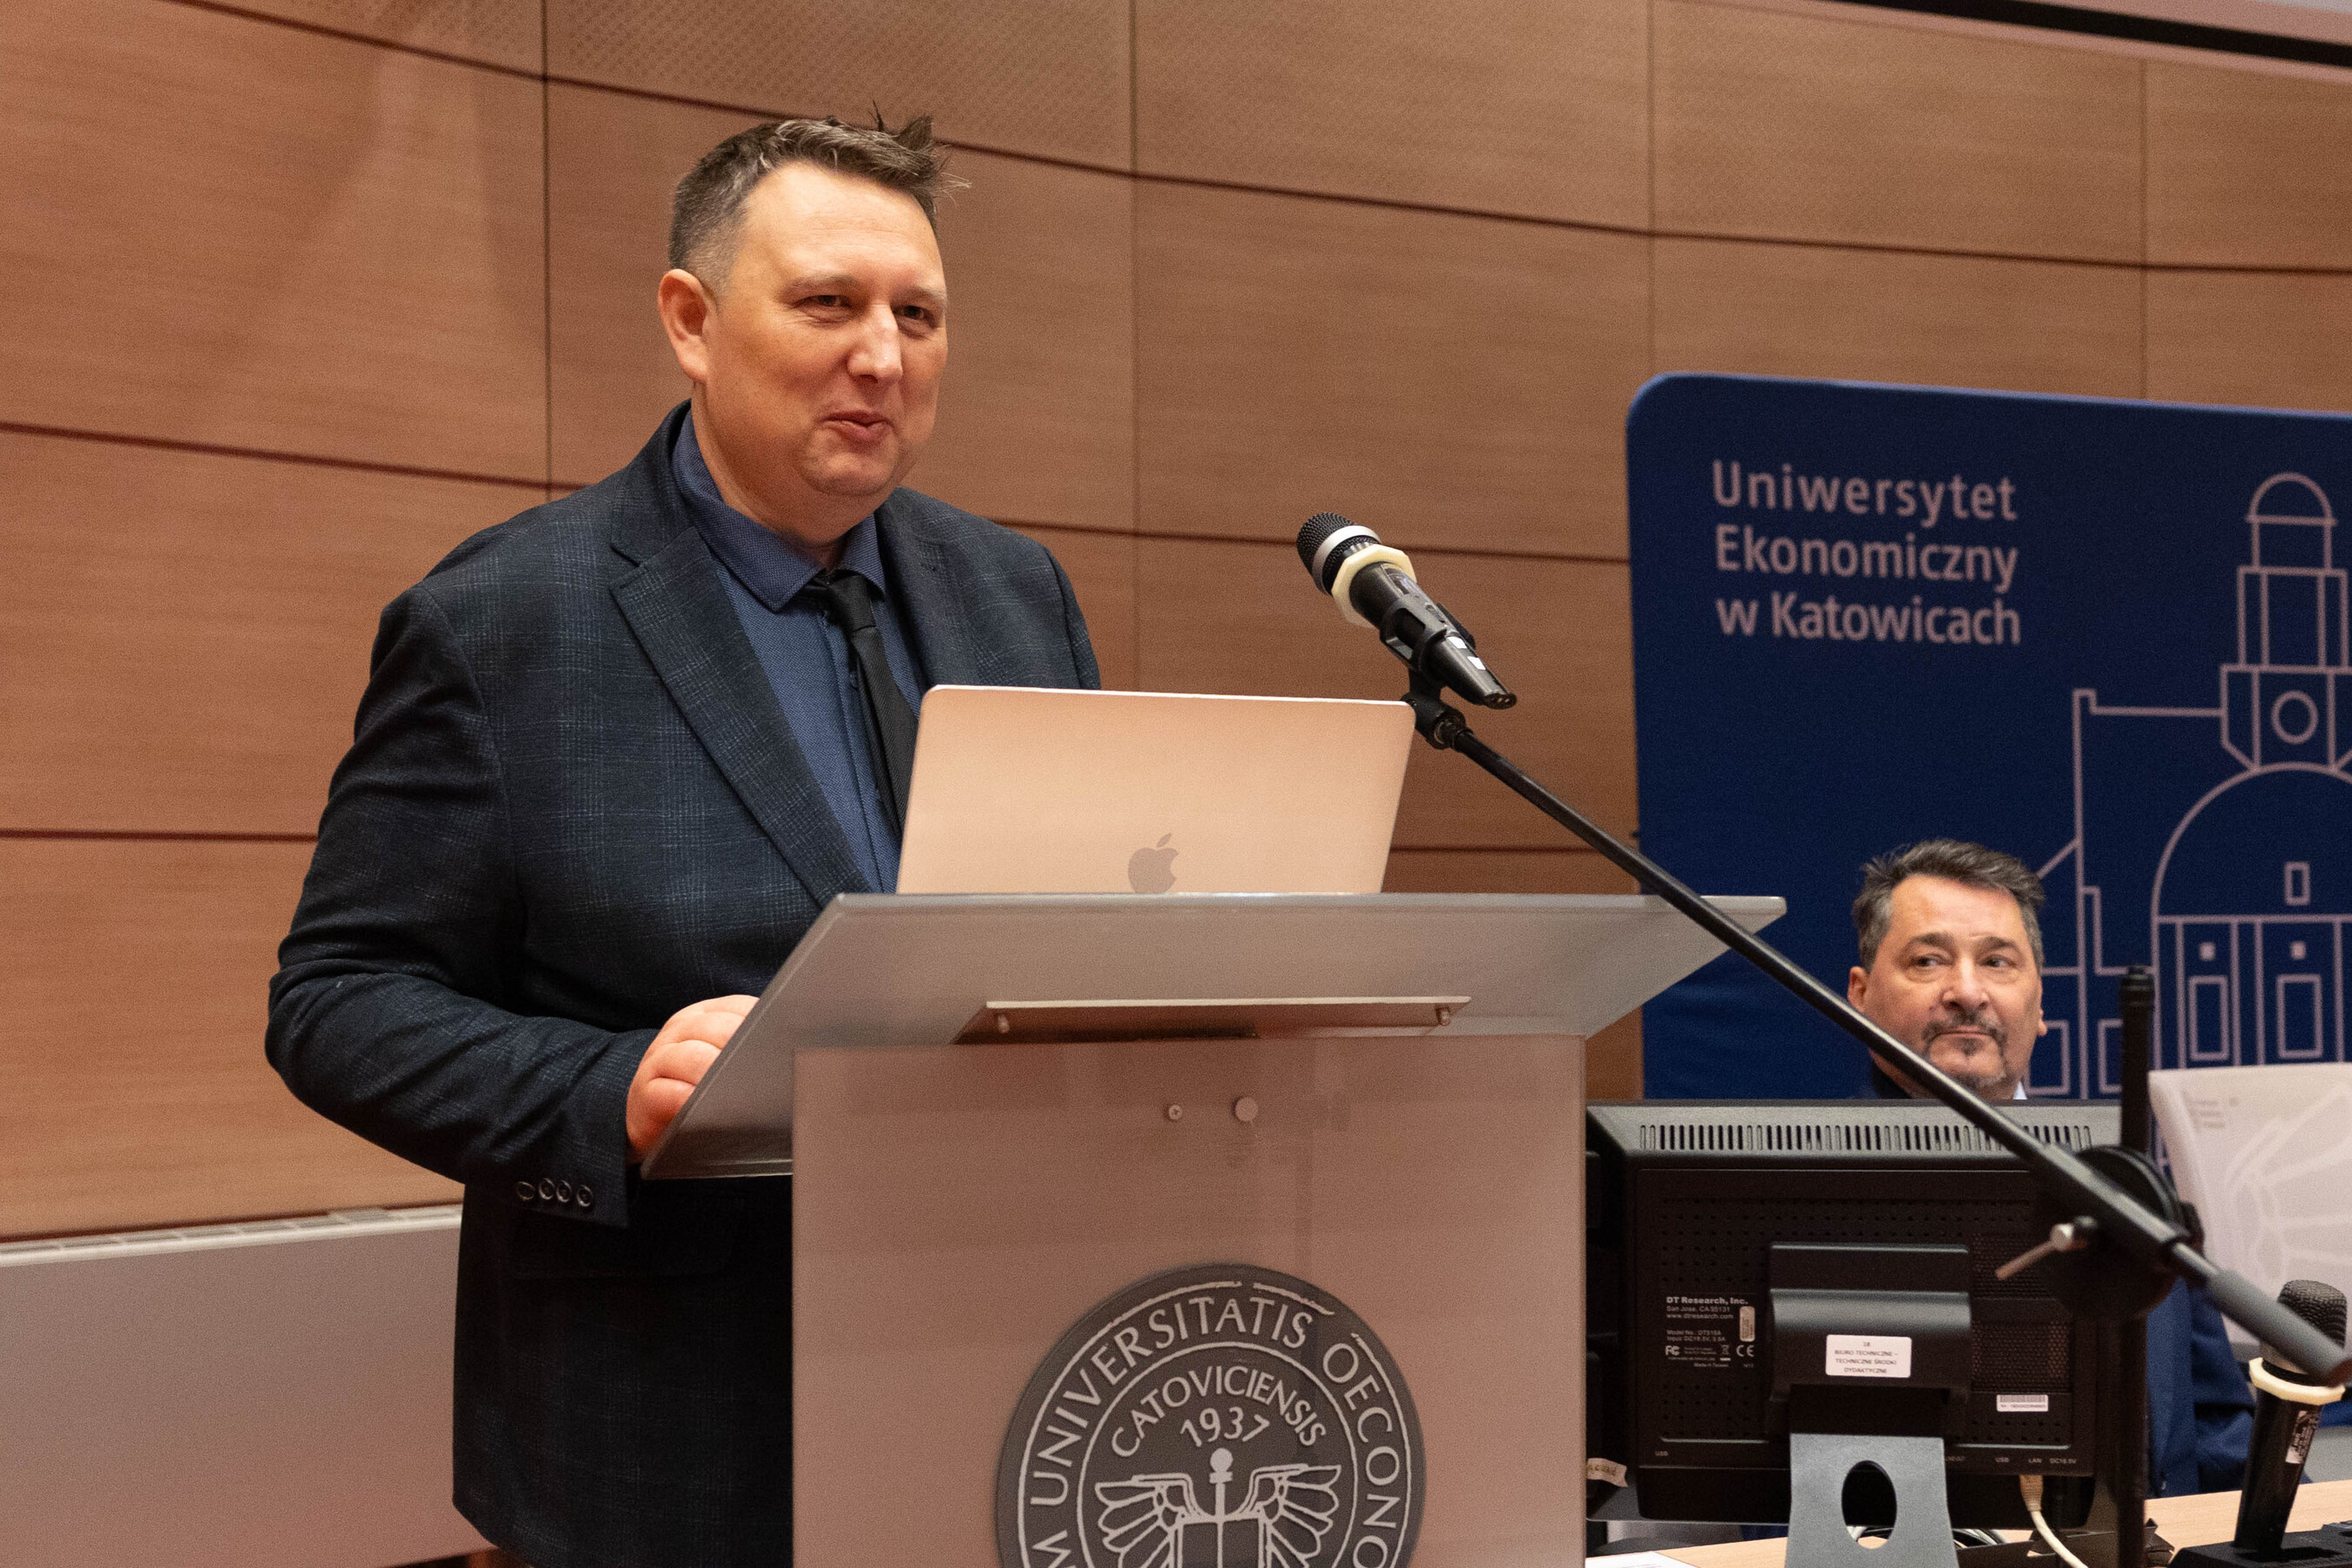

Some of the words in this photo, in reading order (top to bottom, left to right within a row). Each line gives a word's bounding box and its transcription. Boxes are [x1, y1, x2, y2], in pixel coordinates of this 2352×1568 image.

[1712, 458, 2017, 528] Uniwersytet
[1714, 524, 2018, 594] Ekonomiczny
[1715, 598, 1759, 637] w
[1771, 591, 2022, 645] Katowicach
[1680, 1296, 1729, 1306] Research,
[1030, 1295, 1314, 1506] UNIVERSITATIS
[1111, 1366, 1327, 1457] CATOVICIENSIS
[1179, 1406, 1270, 1448] 1937
